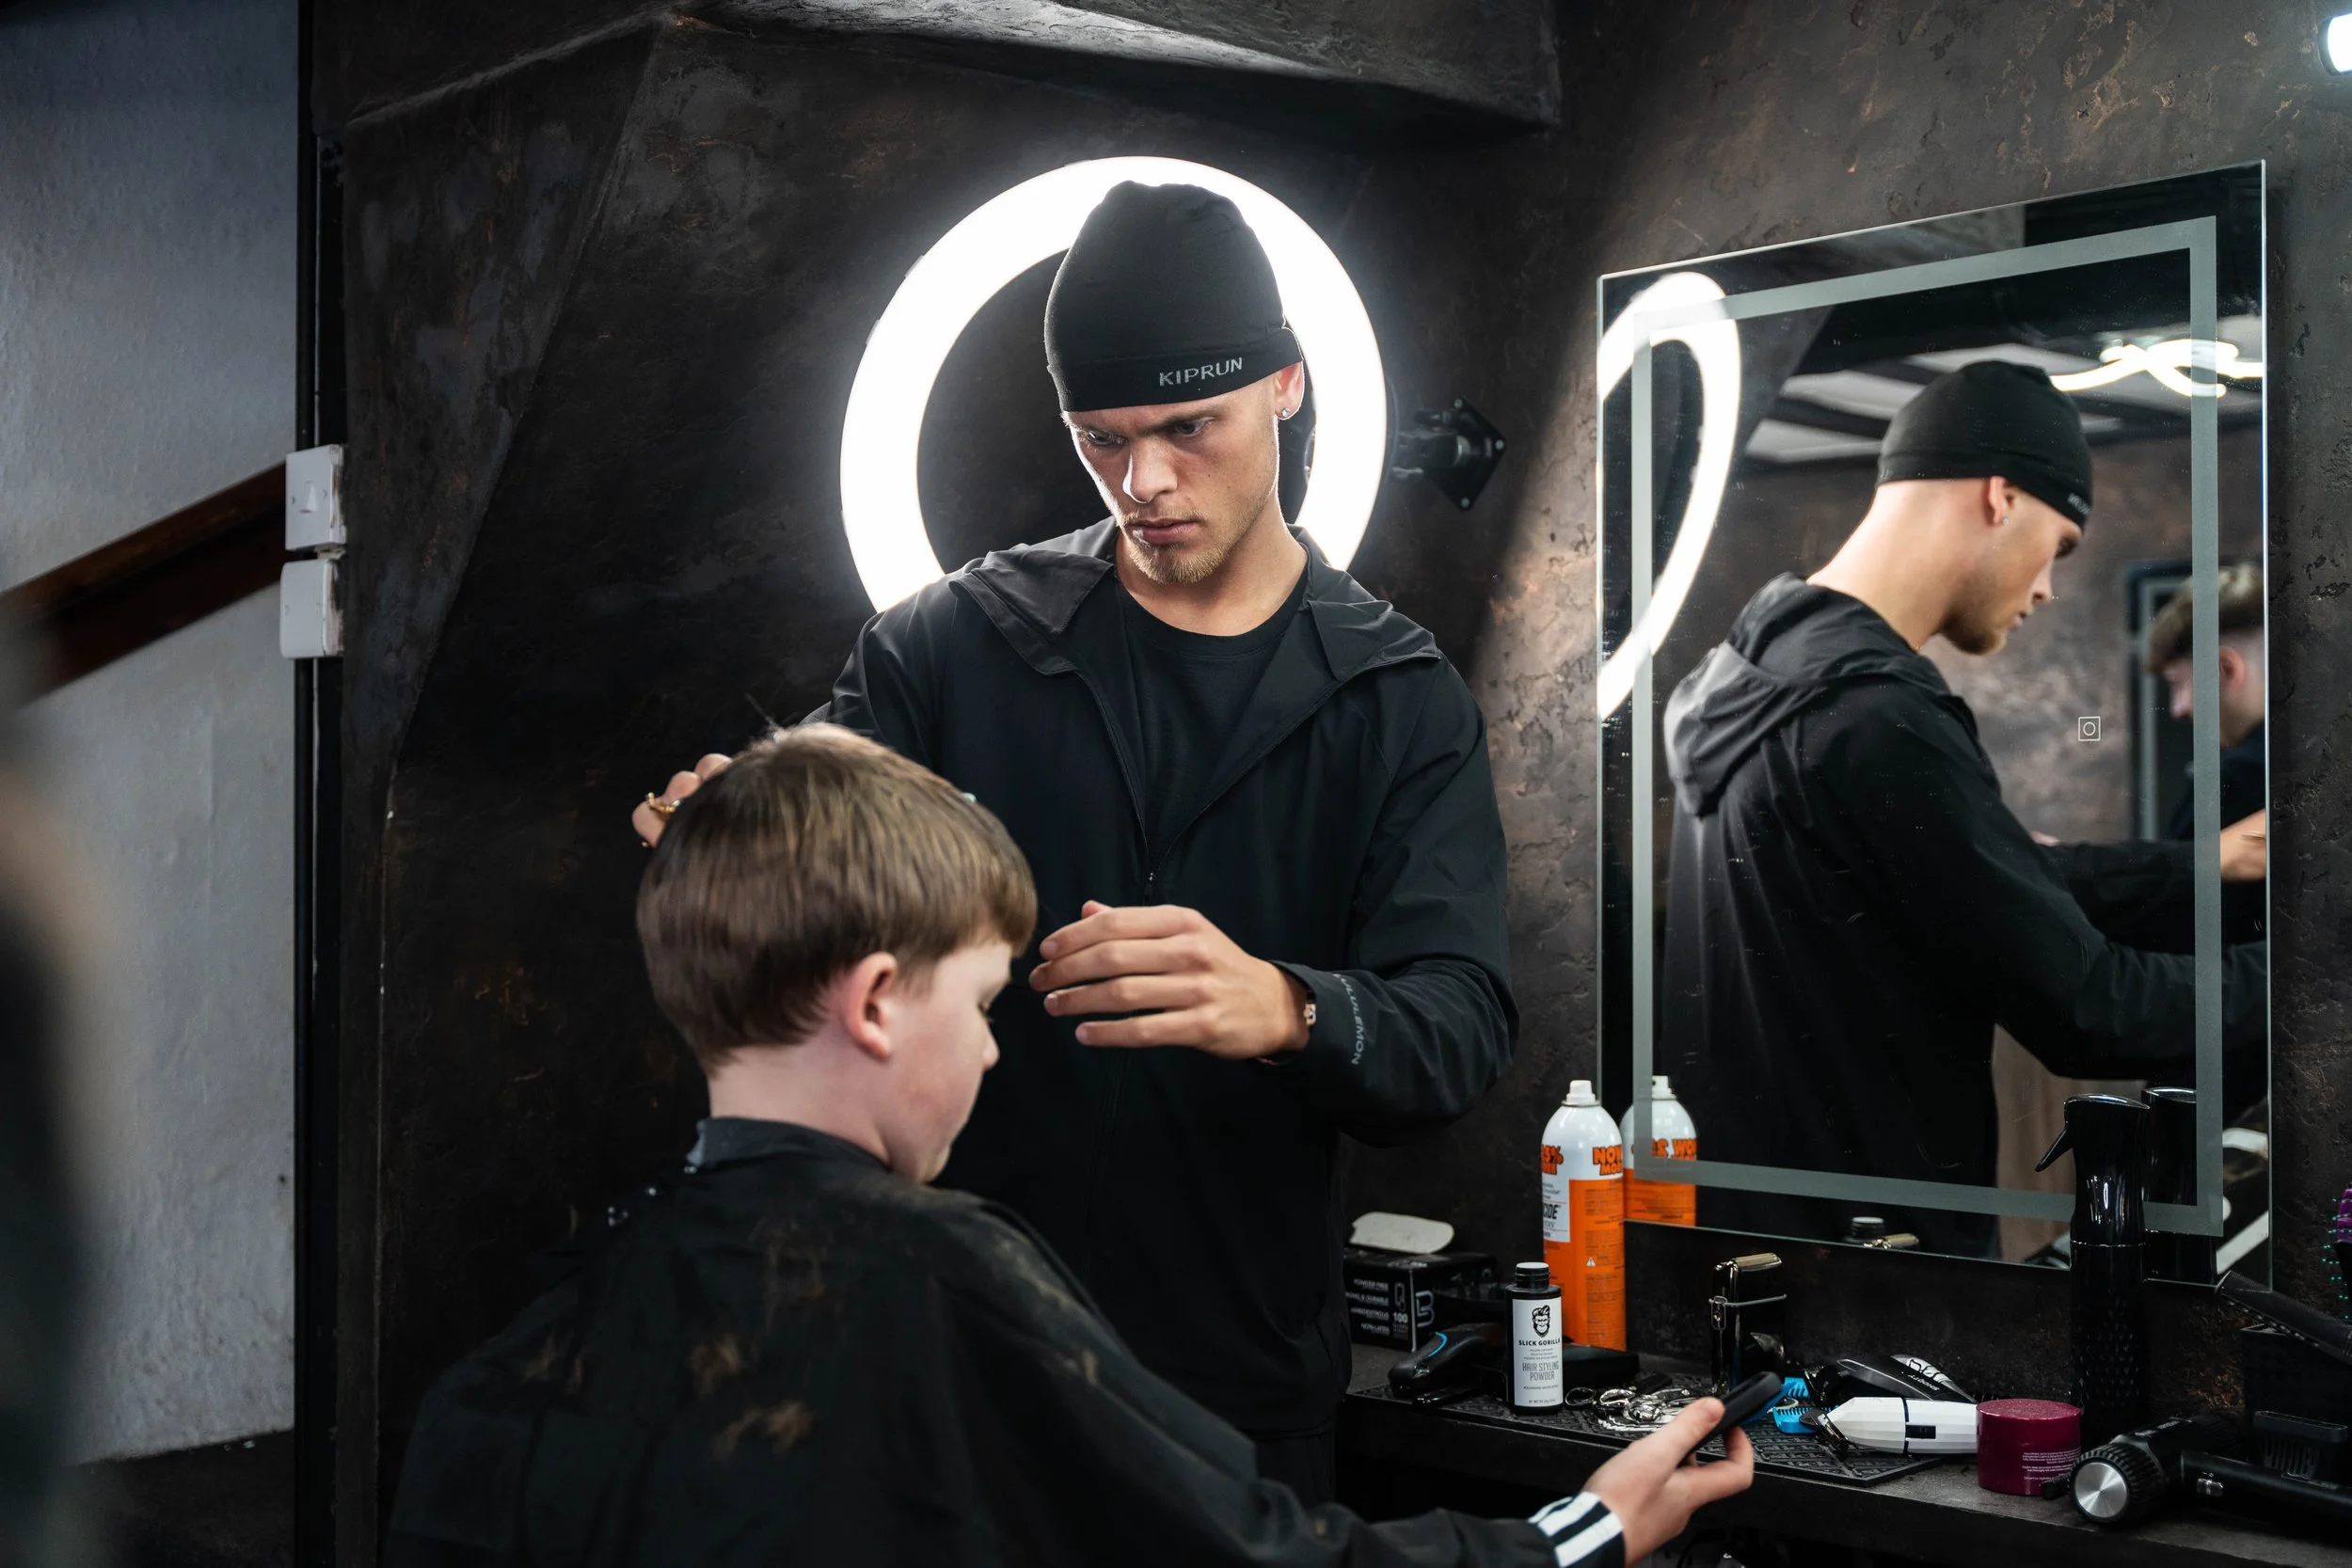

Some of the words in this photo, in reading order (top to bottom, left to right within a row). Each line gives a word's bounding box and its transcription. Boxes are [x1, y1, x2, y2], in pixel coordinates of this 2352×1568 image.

[1159, 356, 1243, 387] KIPRUN
[1392, 1312, 1408, 1323] 100
[1522, 1362, 1537, 1372] HAIR
[1538, 1361, 1560, 1372] STYLING
[1530, 1371, 1555, 1381] POWDER
